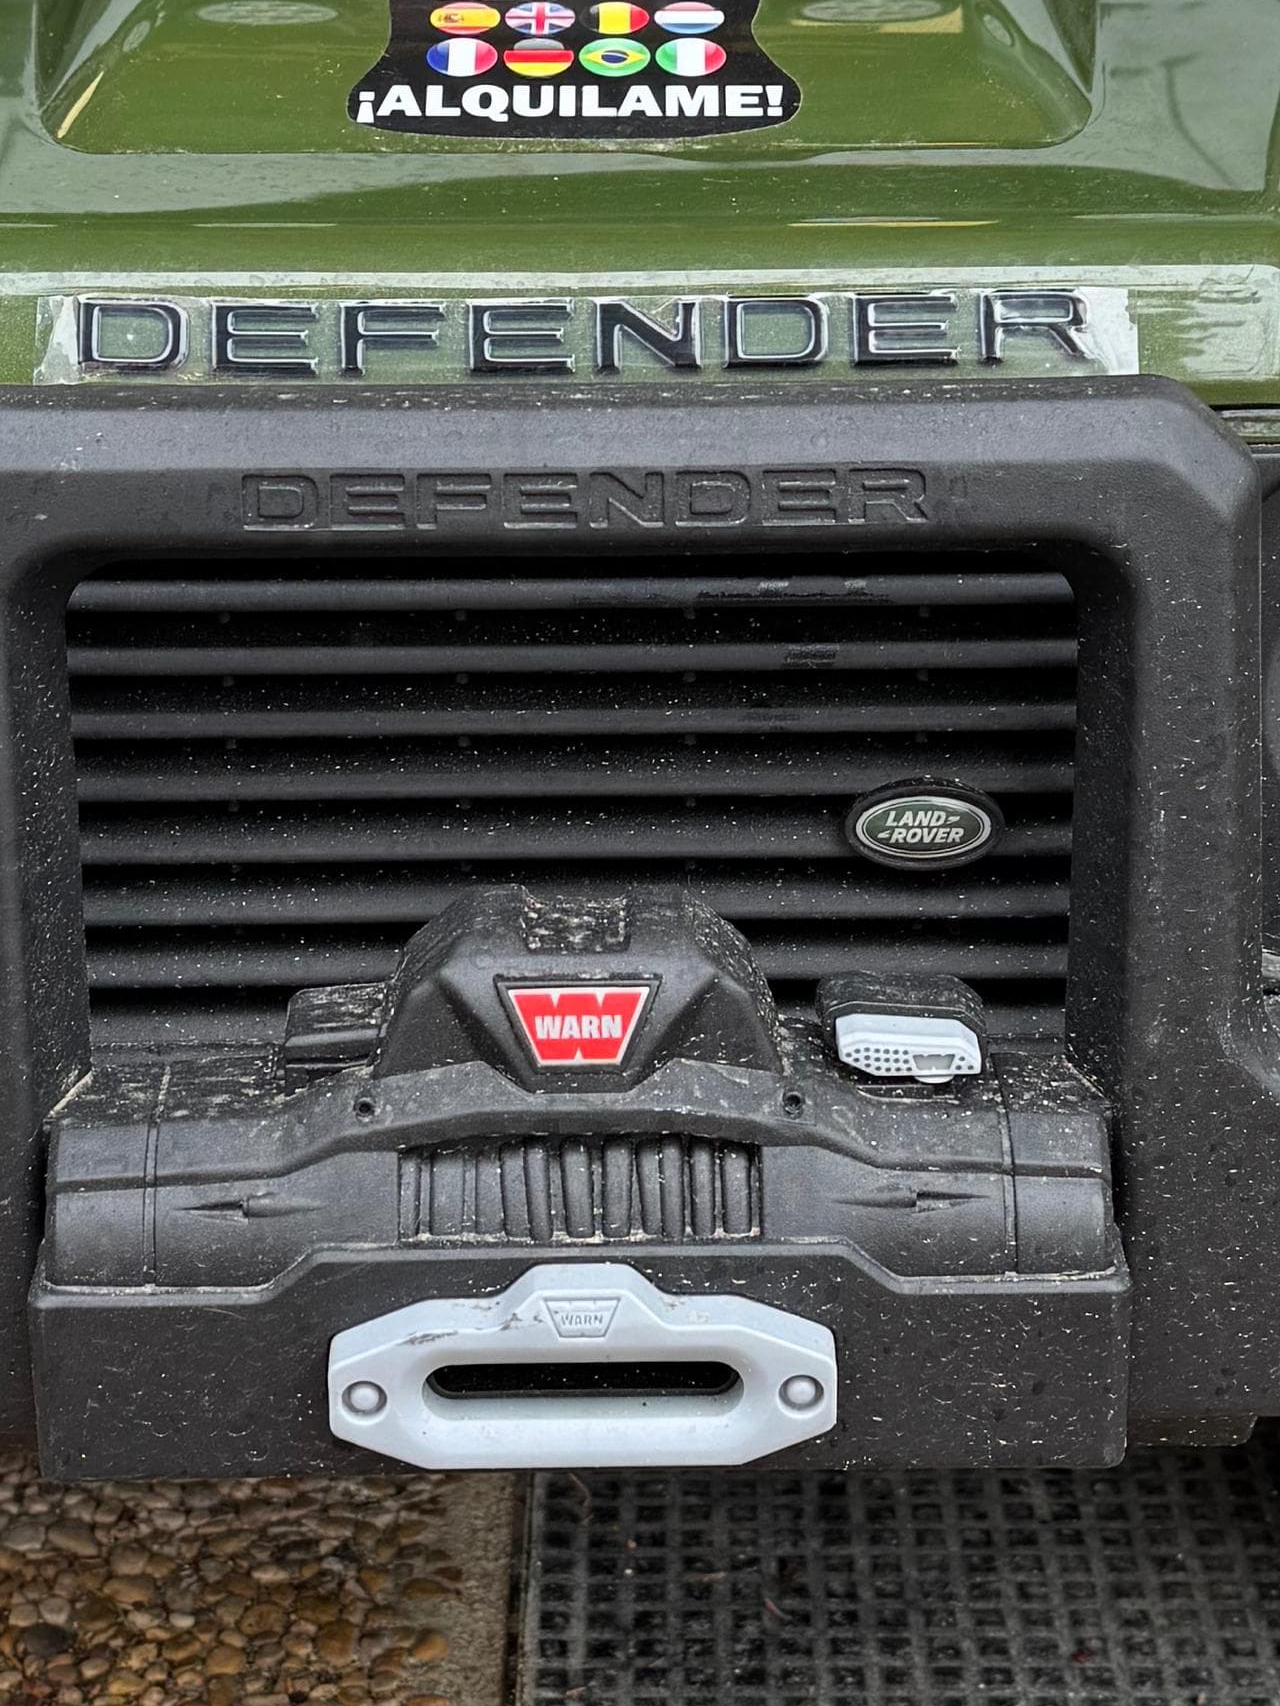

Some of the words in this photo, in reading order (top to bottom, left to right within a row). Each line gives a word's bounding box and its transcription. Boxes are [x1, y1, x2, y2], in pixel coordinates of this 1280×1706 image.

[356, 84, 785, 124] ¡ALQUILAME!
[75, 287, 1092, 376] DEFENDER
[240, 467, 932, 533] DEFENDER
[885, 810, 947, 827] LAND
[888, 827, 965, 844] ROVER
[534, 1014, 623, 1040] WARN
[560, 1313, 604, 1326] WARN
